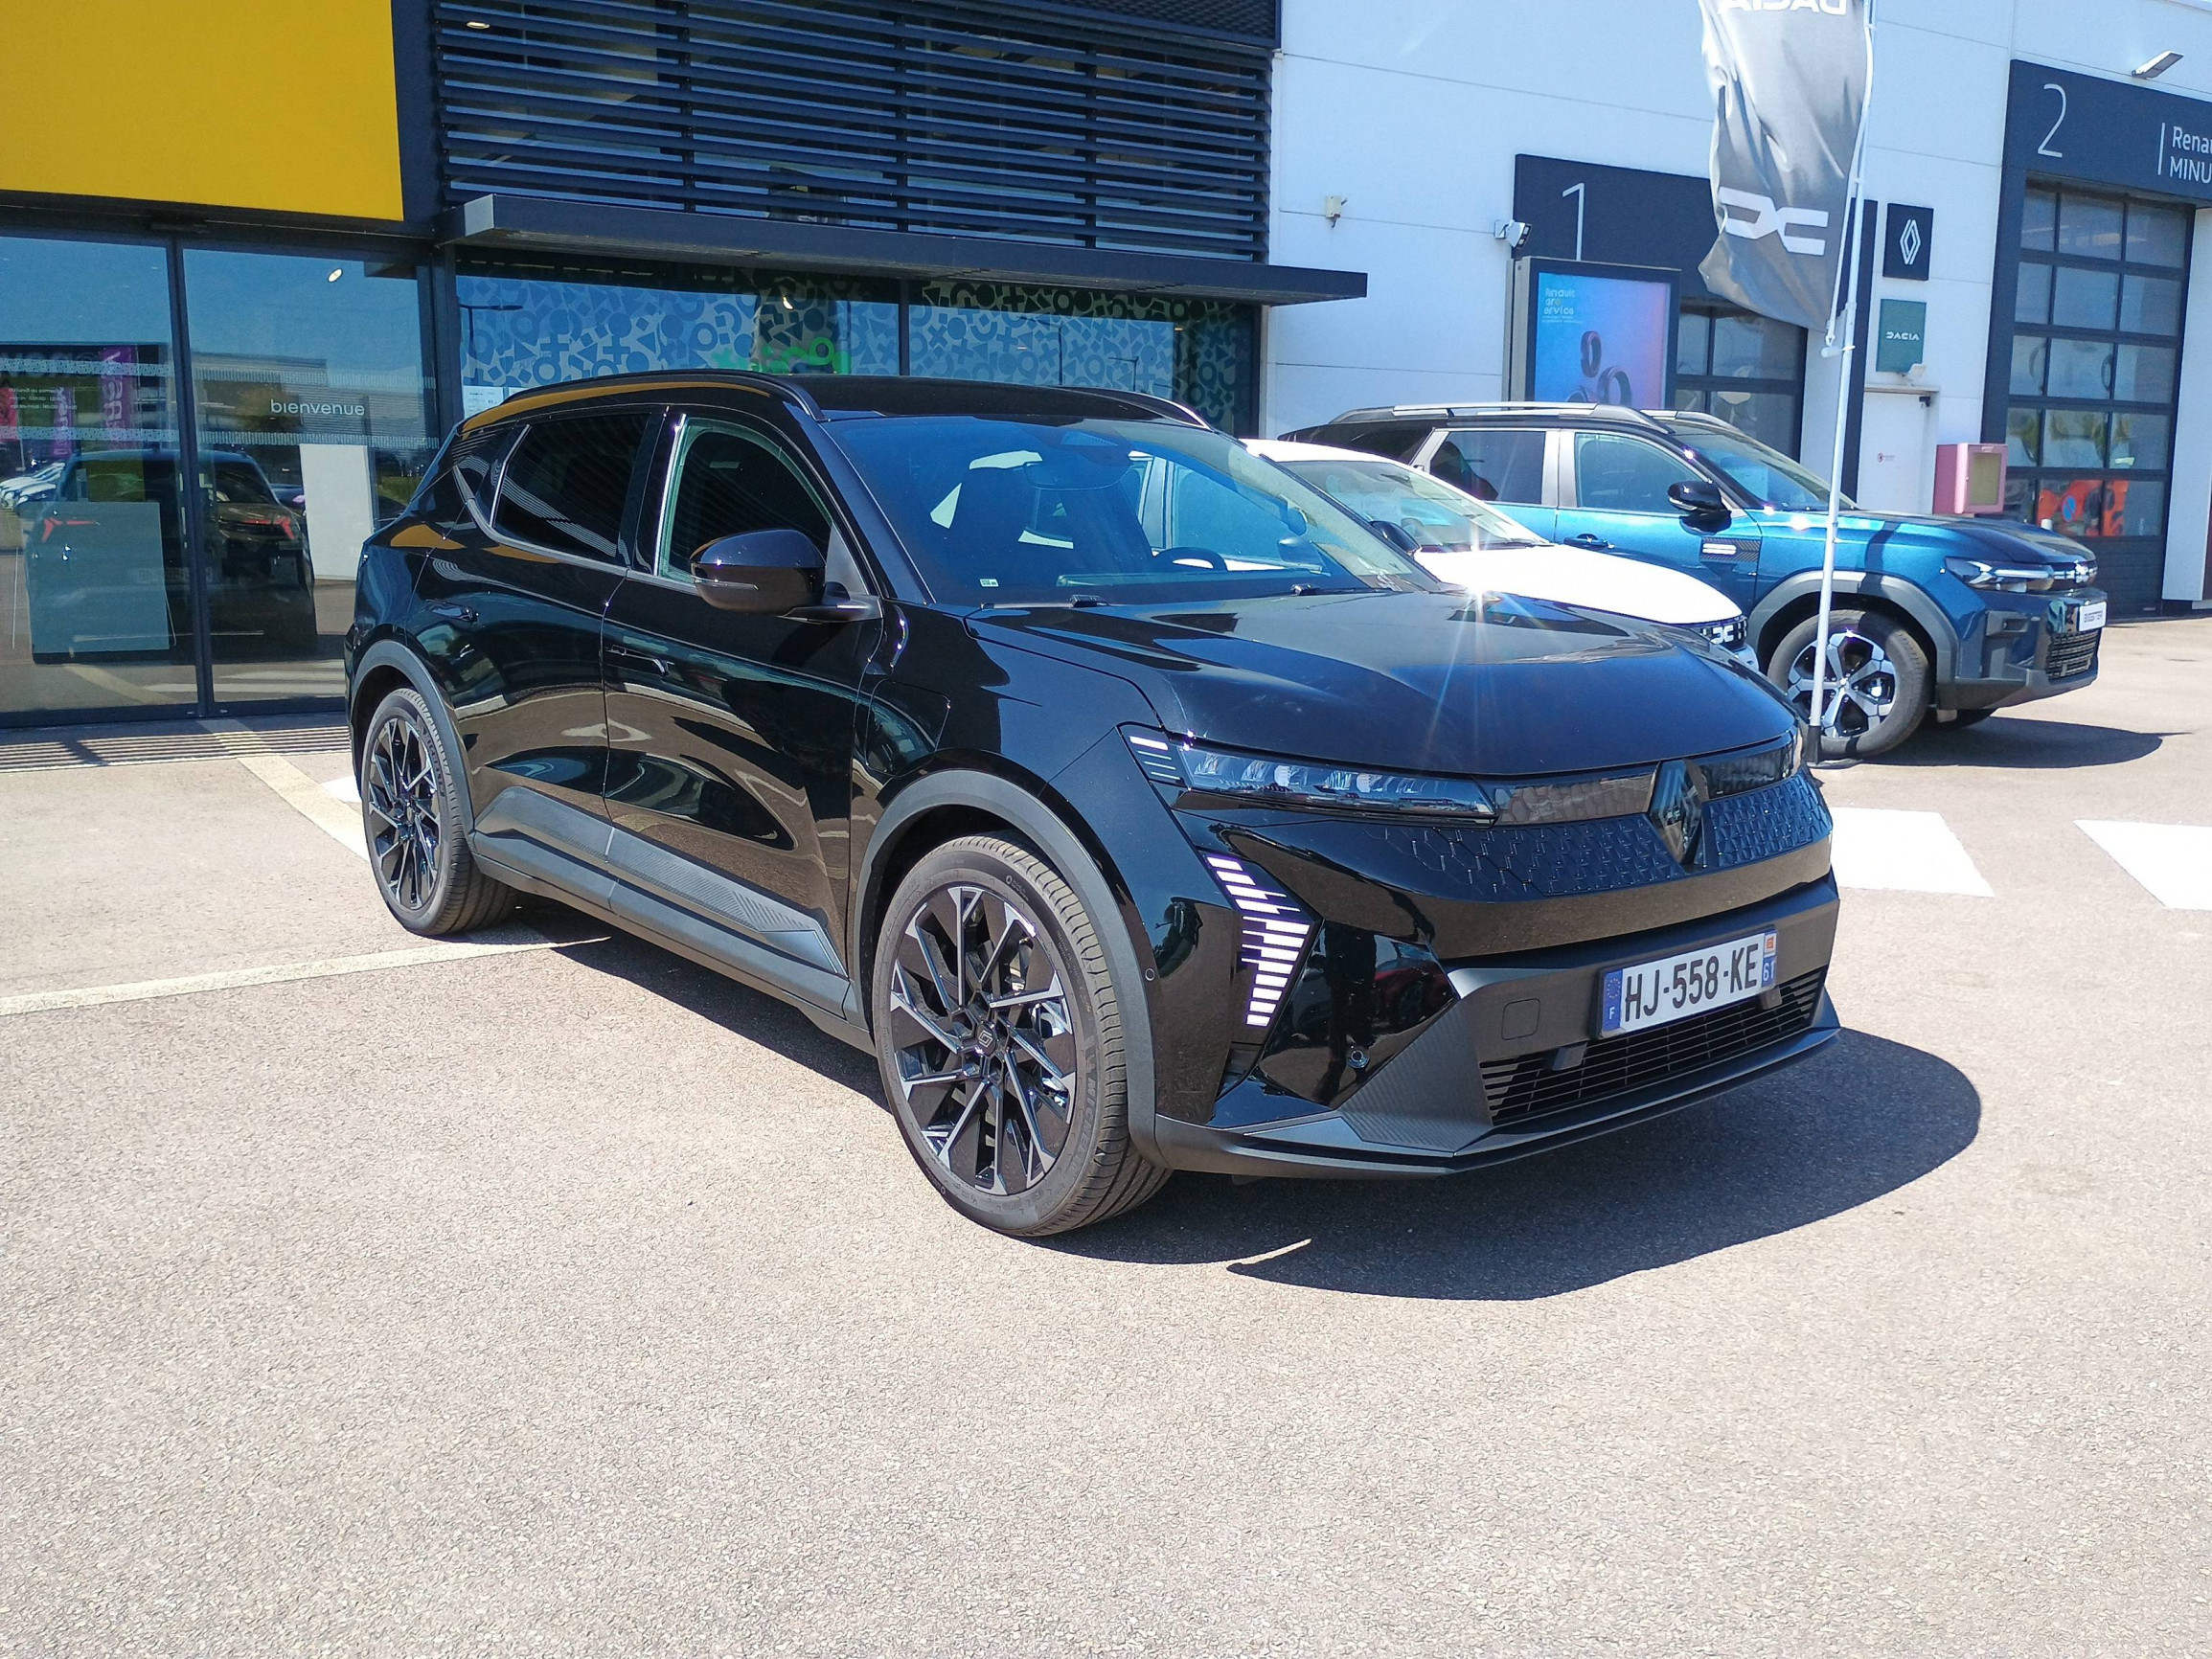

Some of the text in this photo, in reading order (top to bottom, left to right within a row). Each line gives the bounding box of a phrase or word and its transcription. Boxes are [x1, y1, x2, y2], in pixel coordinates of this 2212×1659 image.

[2037, 83, 2066, 158] 2
[2169, 155, 2212, 183] MINU
[1562, 182, 1585, 261] 1
[1885, 331, 1920, 341] DACIA
[270, 398, 365, 416] bienvenue
[1625, 943, 1759, 1023] HJ-558-KE
[1609, 1007, 1616, 1020] F
